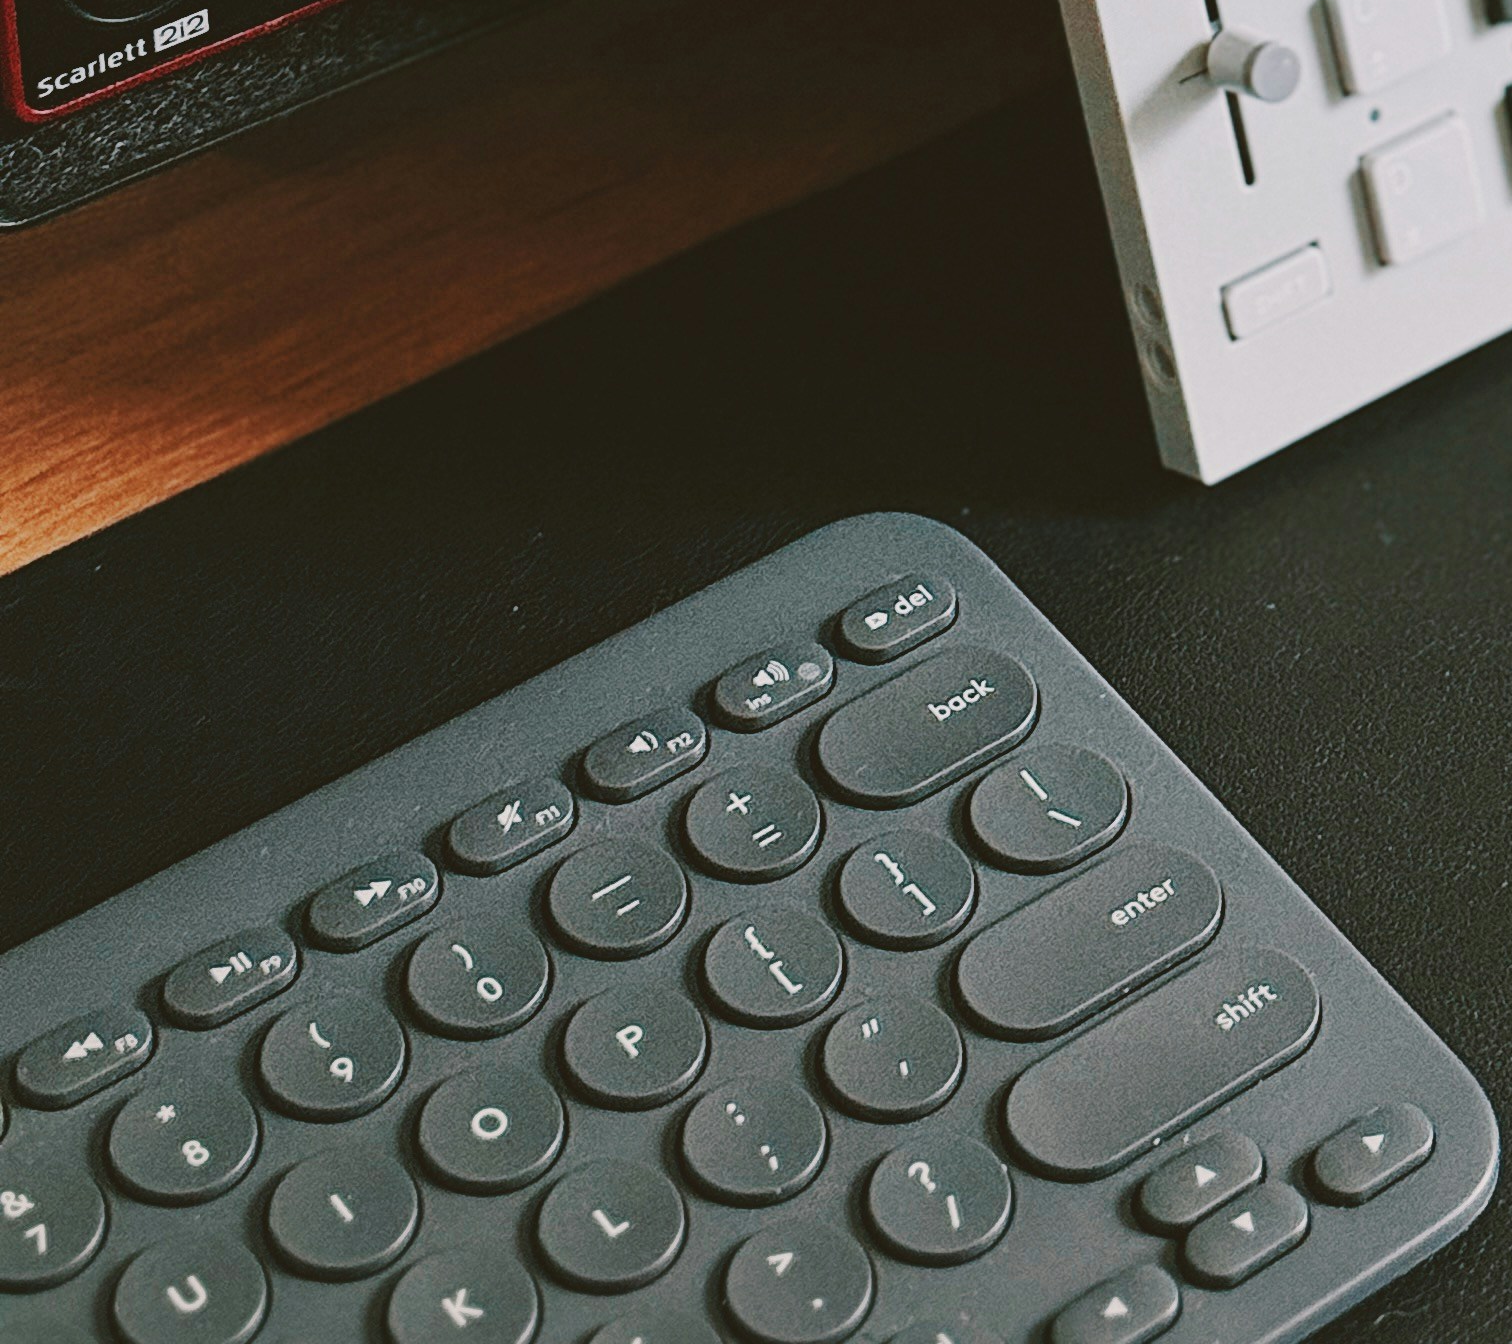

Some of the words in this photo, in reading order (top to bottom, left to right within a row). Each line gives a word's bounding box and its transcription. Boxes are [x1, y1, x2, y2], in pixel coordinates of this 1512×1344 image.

[37, 39, 148, 99] Scarlett
[160, 14, 205, 47] 2i2
[894, 584, 934, 615] del
[928, 679, 995, 722] back
[666, 731, 695, 754] F12
[397, 877, 426, 901] F10
[1110, 878, 1176, 926] enter
[260, 955, 281, 975] F9
[476, 976, 503, 1002] 0
[1216, 984, 1278, 1031] shift
[114, 1033, 138, 1054] F8
[616, 1025, 643, 1059] P
[329, 1057, 353, 1083] 9
[471, 1107, 508, 1139] O
[181, 1140, 210, 1167] 8
[24, 1223, 47, 1255] 7
[592, 1209, 630, 1238] L
[166, 1275, 208, 1313] U
[442, 1287, 484, 1328] K
